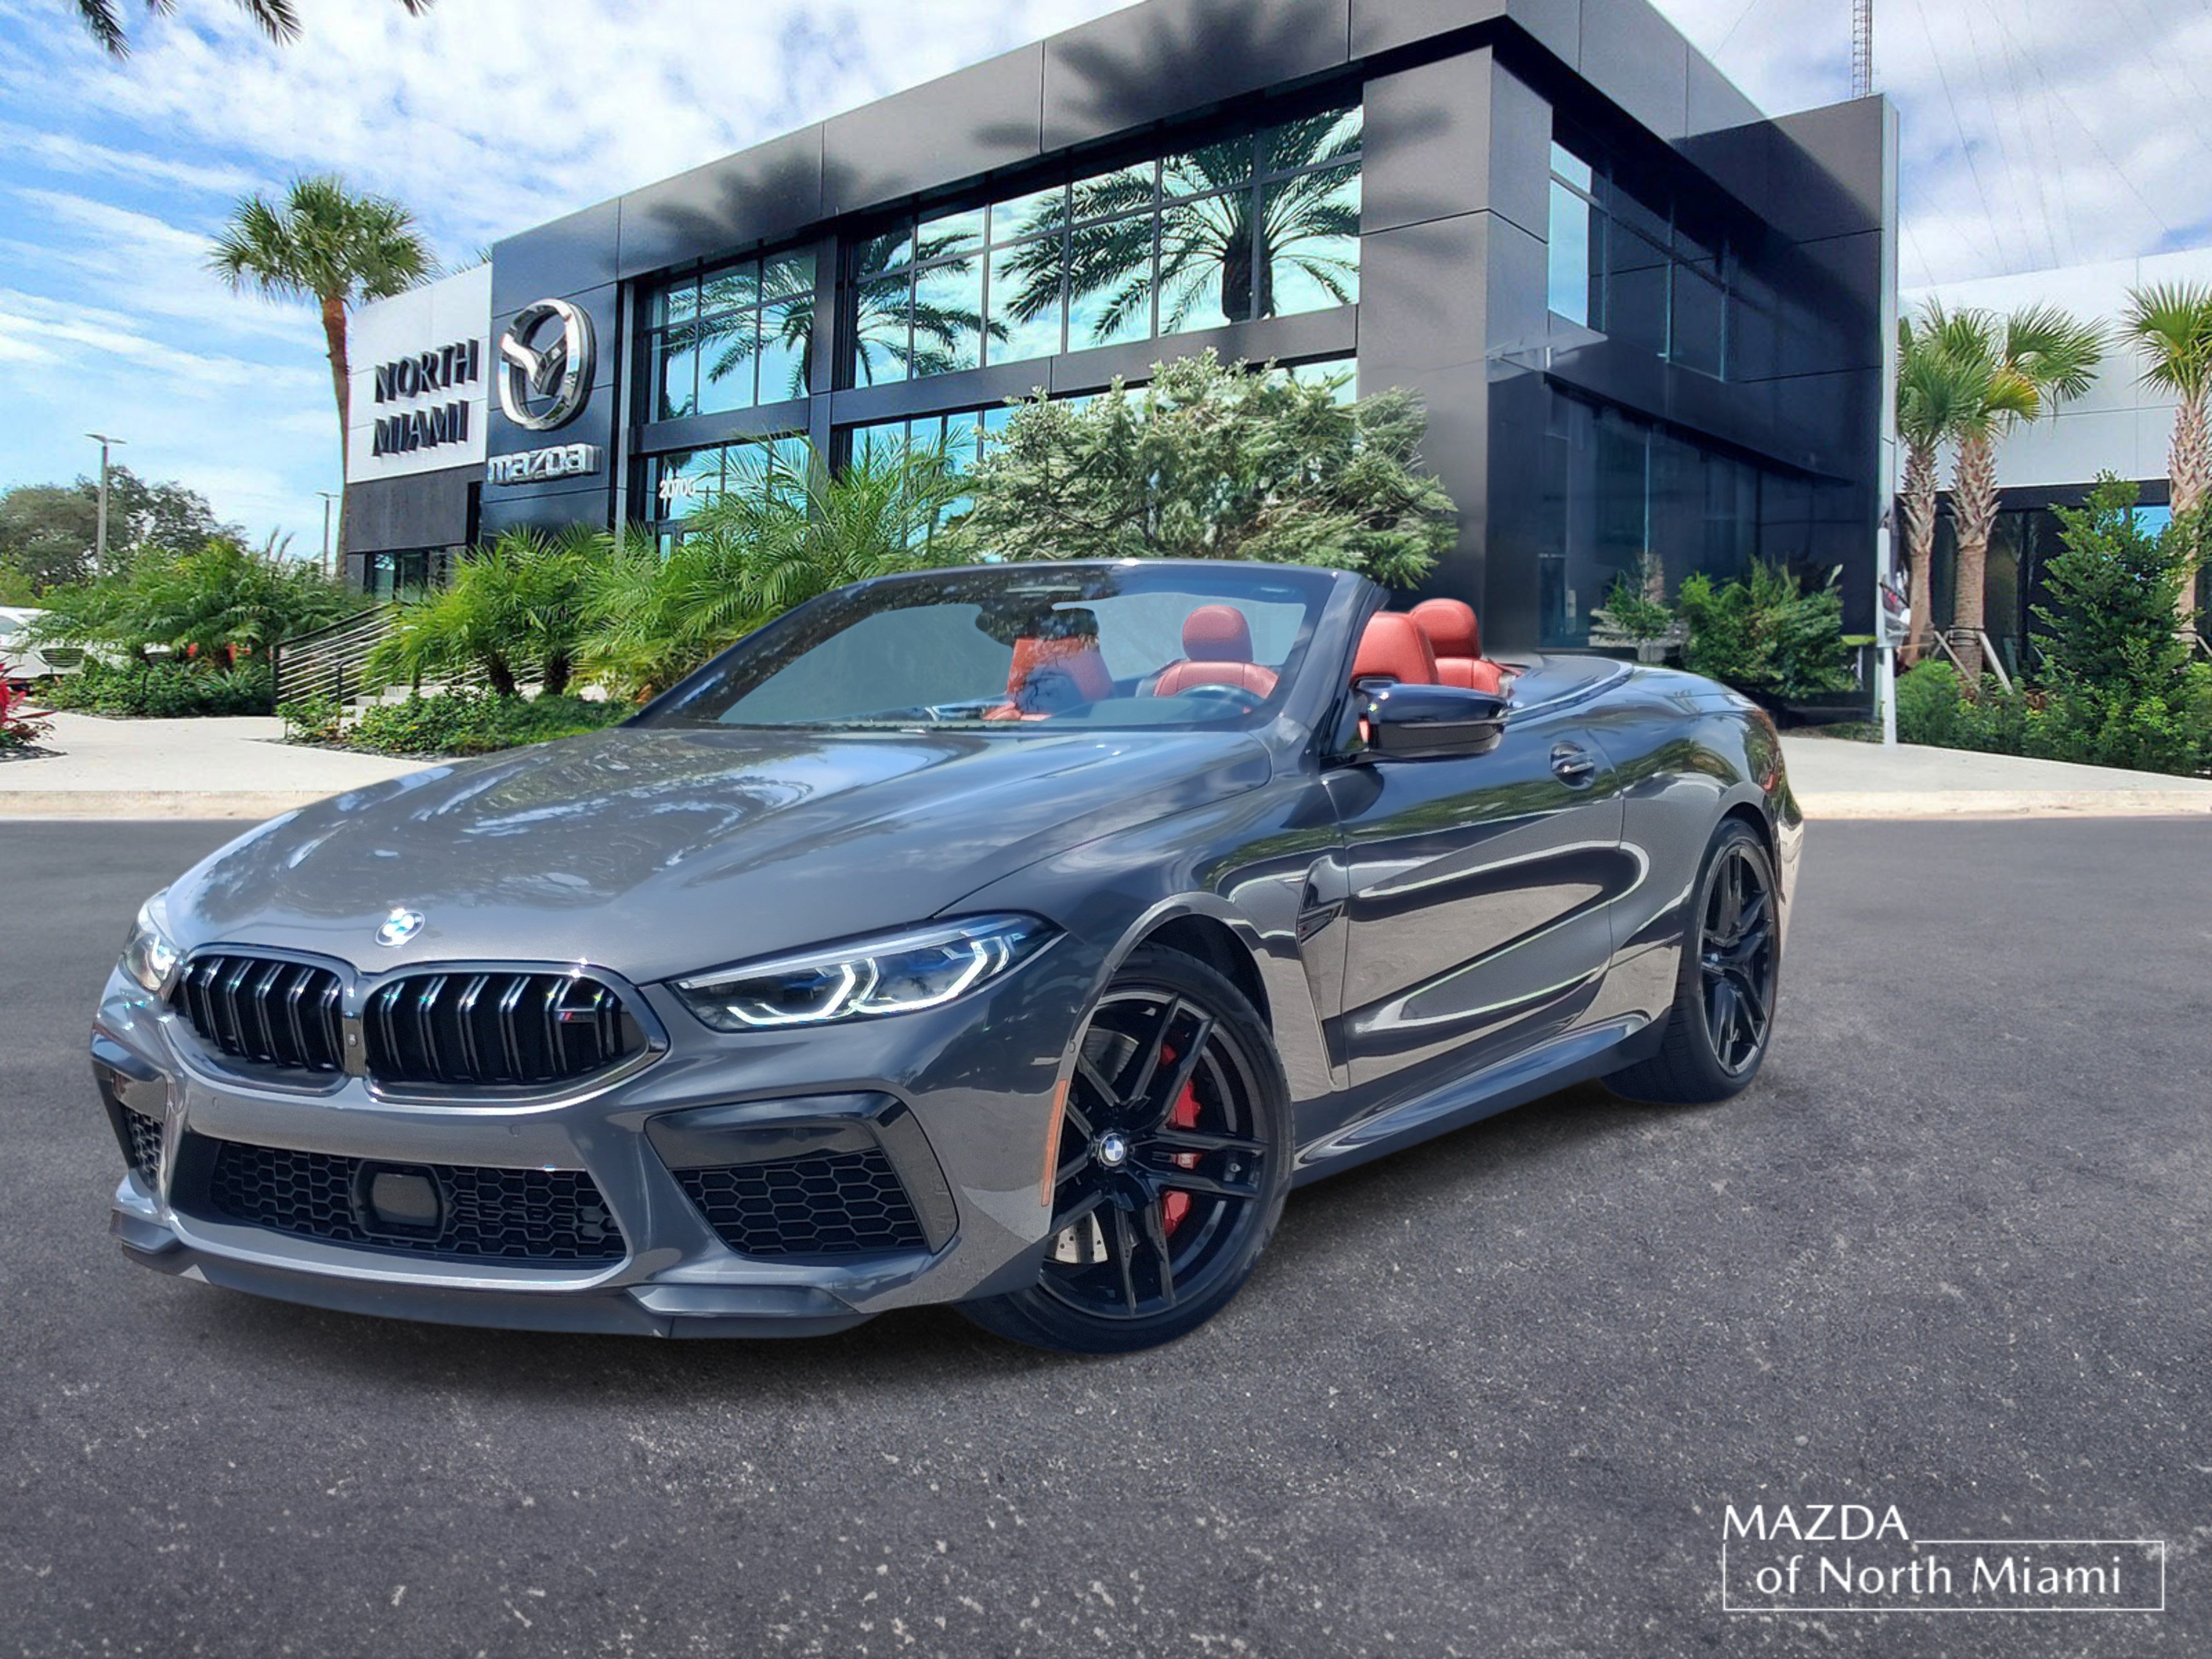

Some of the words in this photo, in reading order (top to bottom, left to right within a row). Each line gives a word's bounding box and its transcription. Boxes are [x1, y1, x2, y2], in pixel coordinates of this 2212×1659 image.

[375, 339, 479, 403] NORTH
[372, 400, 469, 457] MIAMI
[488, 443, 598, 485] mazda
